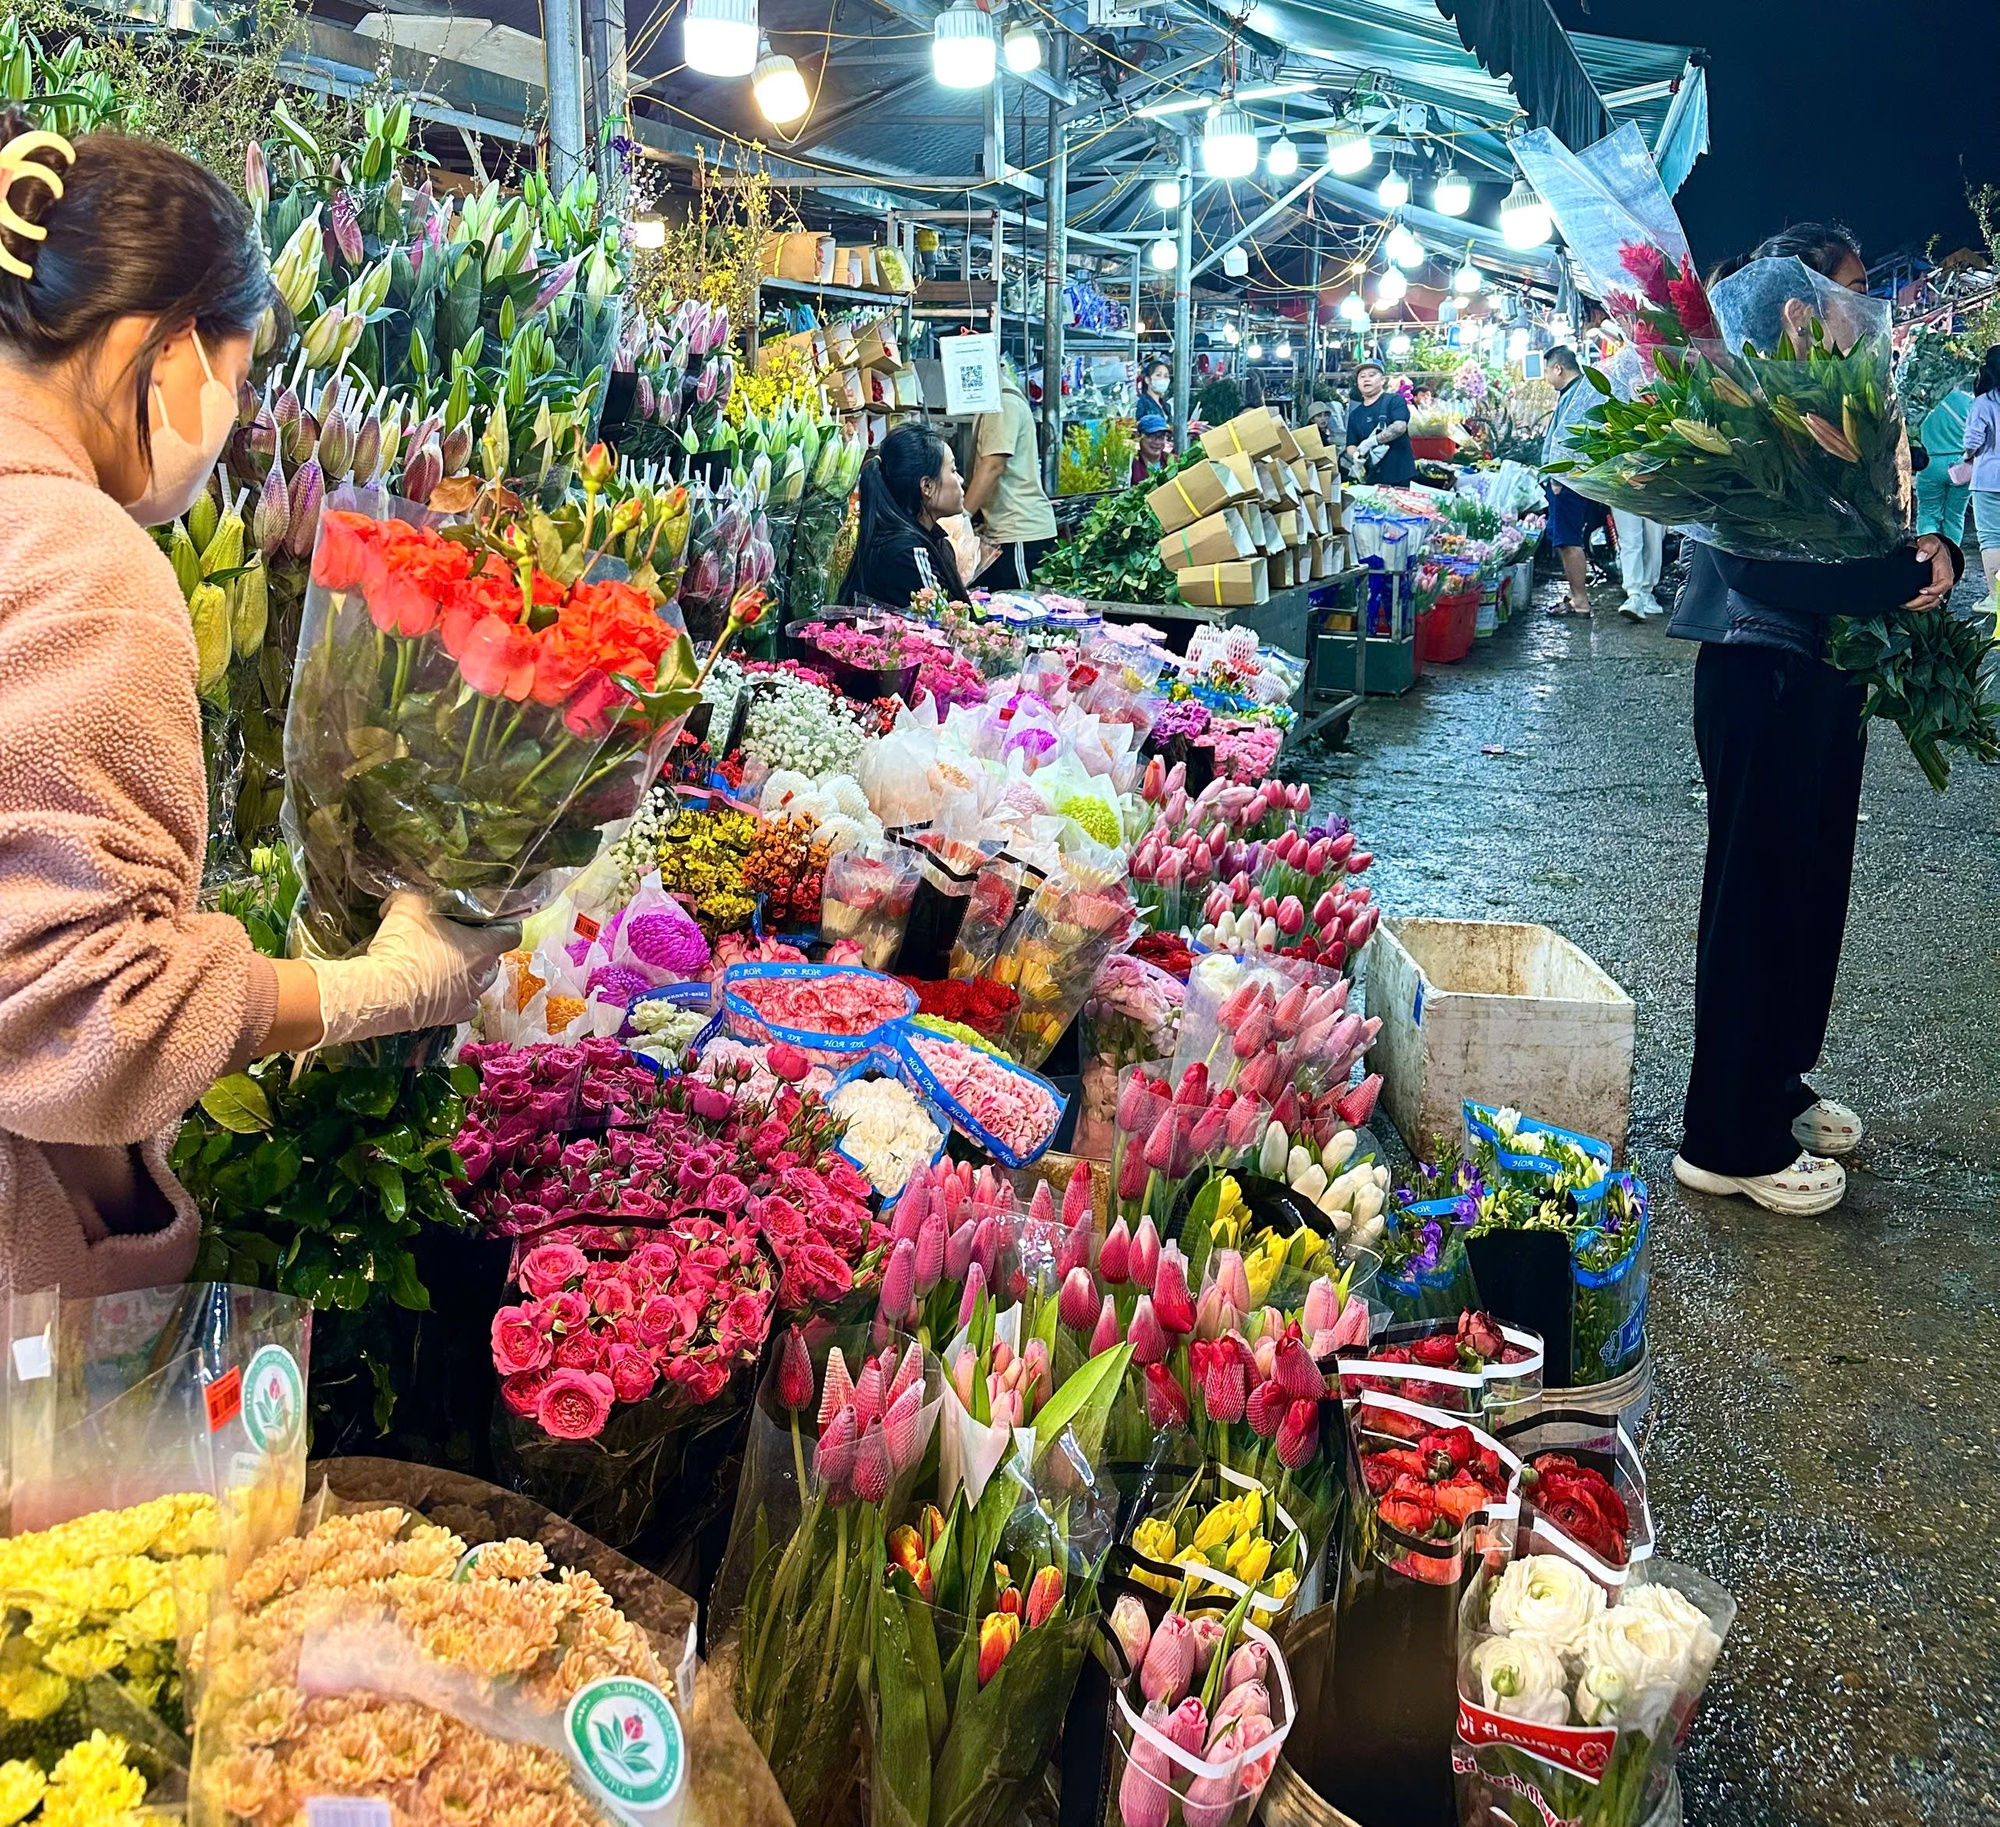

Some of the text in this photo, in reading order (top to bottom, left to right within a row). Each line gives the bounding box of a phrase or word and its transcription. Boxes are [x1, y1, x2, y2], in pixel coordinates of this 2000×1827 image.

[823, 1039, 845, 1048] HOA
[907, 1056, 923, 1077] HOA
[948, 1105, 968, 1124] HOA
[1512, 1159, 1534, 1168] HOA
[1481, 1721, 1573, 1760] flowers
